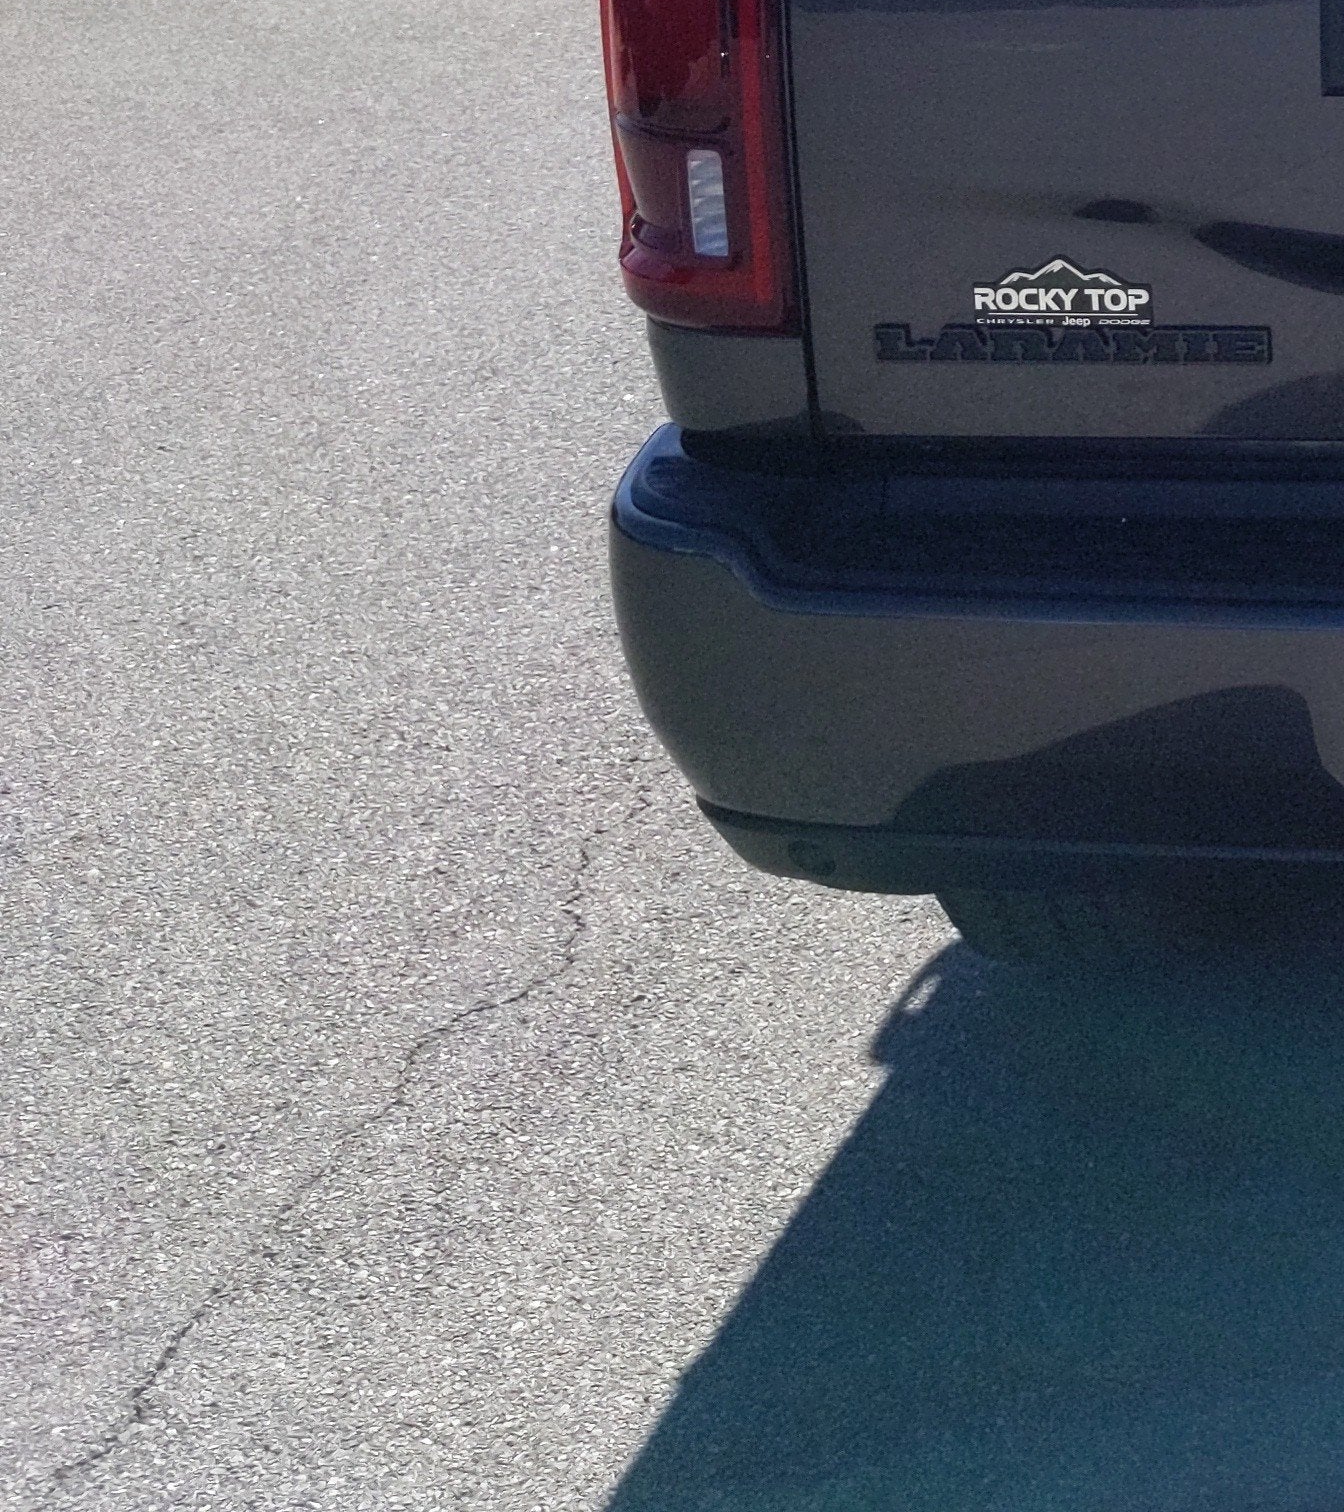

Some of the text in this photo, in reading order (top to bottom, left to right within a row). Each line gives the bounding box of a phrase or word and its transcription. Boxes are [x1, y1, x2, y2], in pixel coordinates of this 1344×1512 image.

[974, 287, 1150, 311] ROCKY TOP
[1062, 316, 1091, 327] Jeep
[873, 323, 1273, 364] LARAMIE
